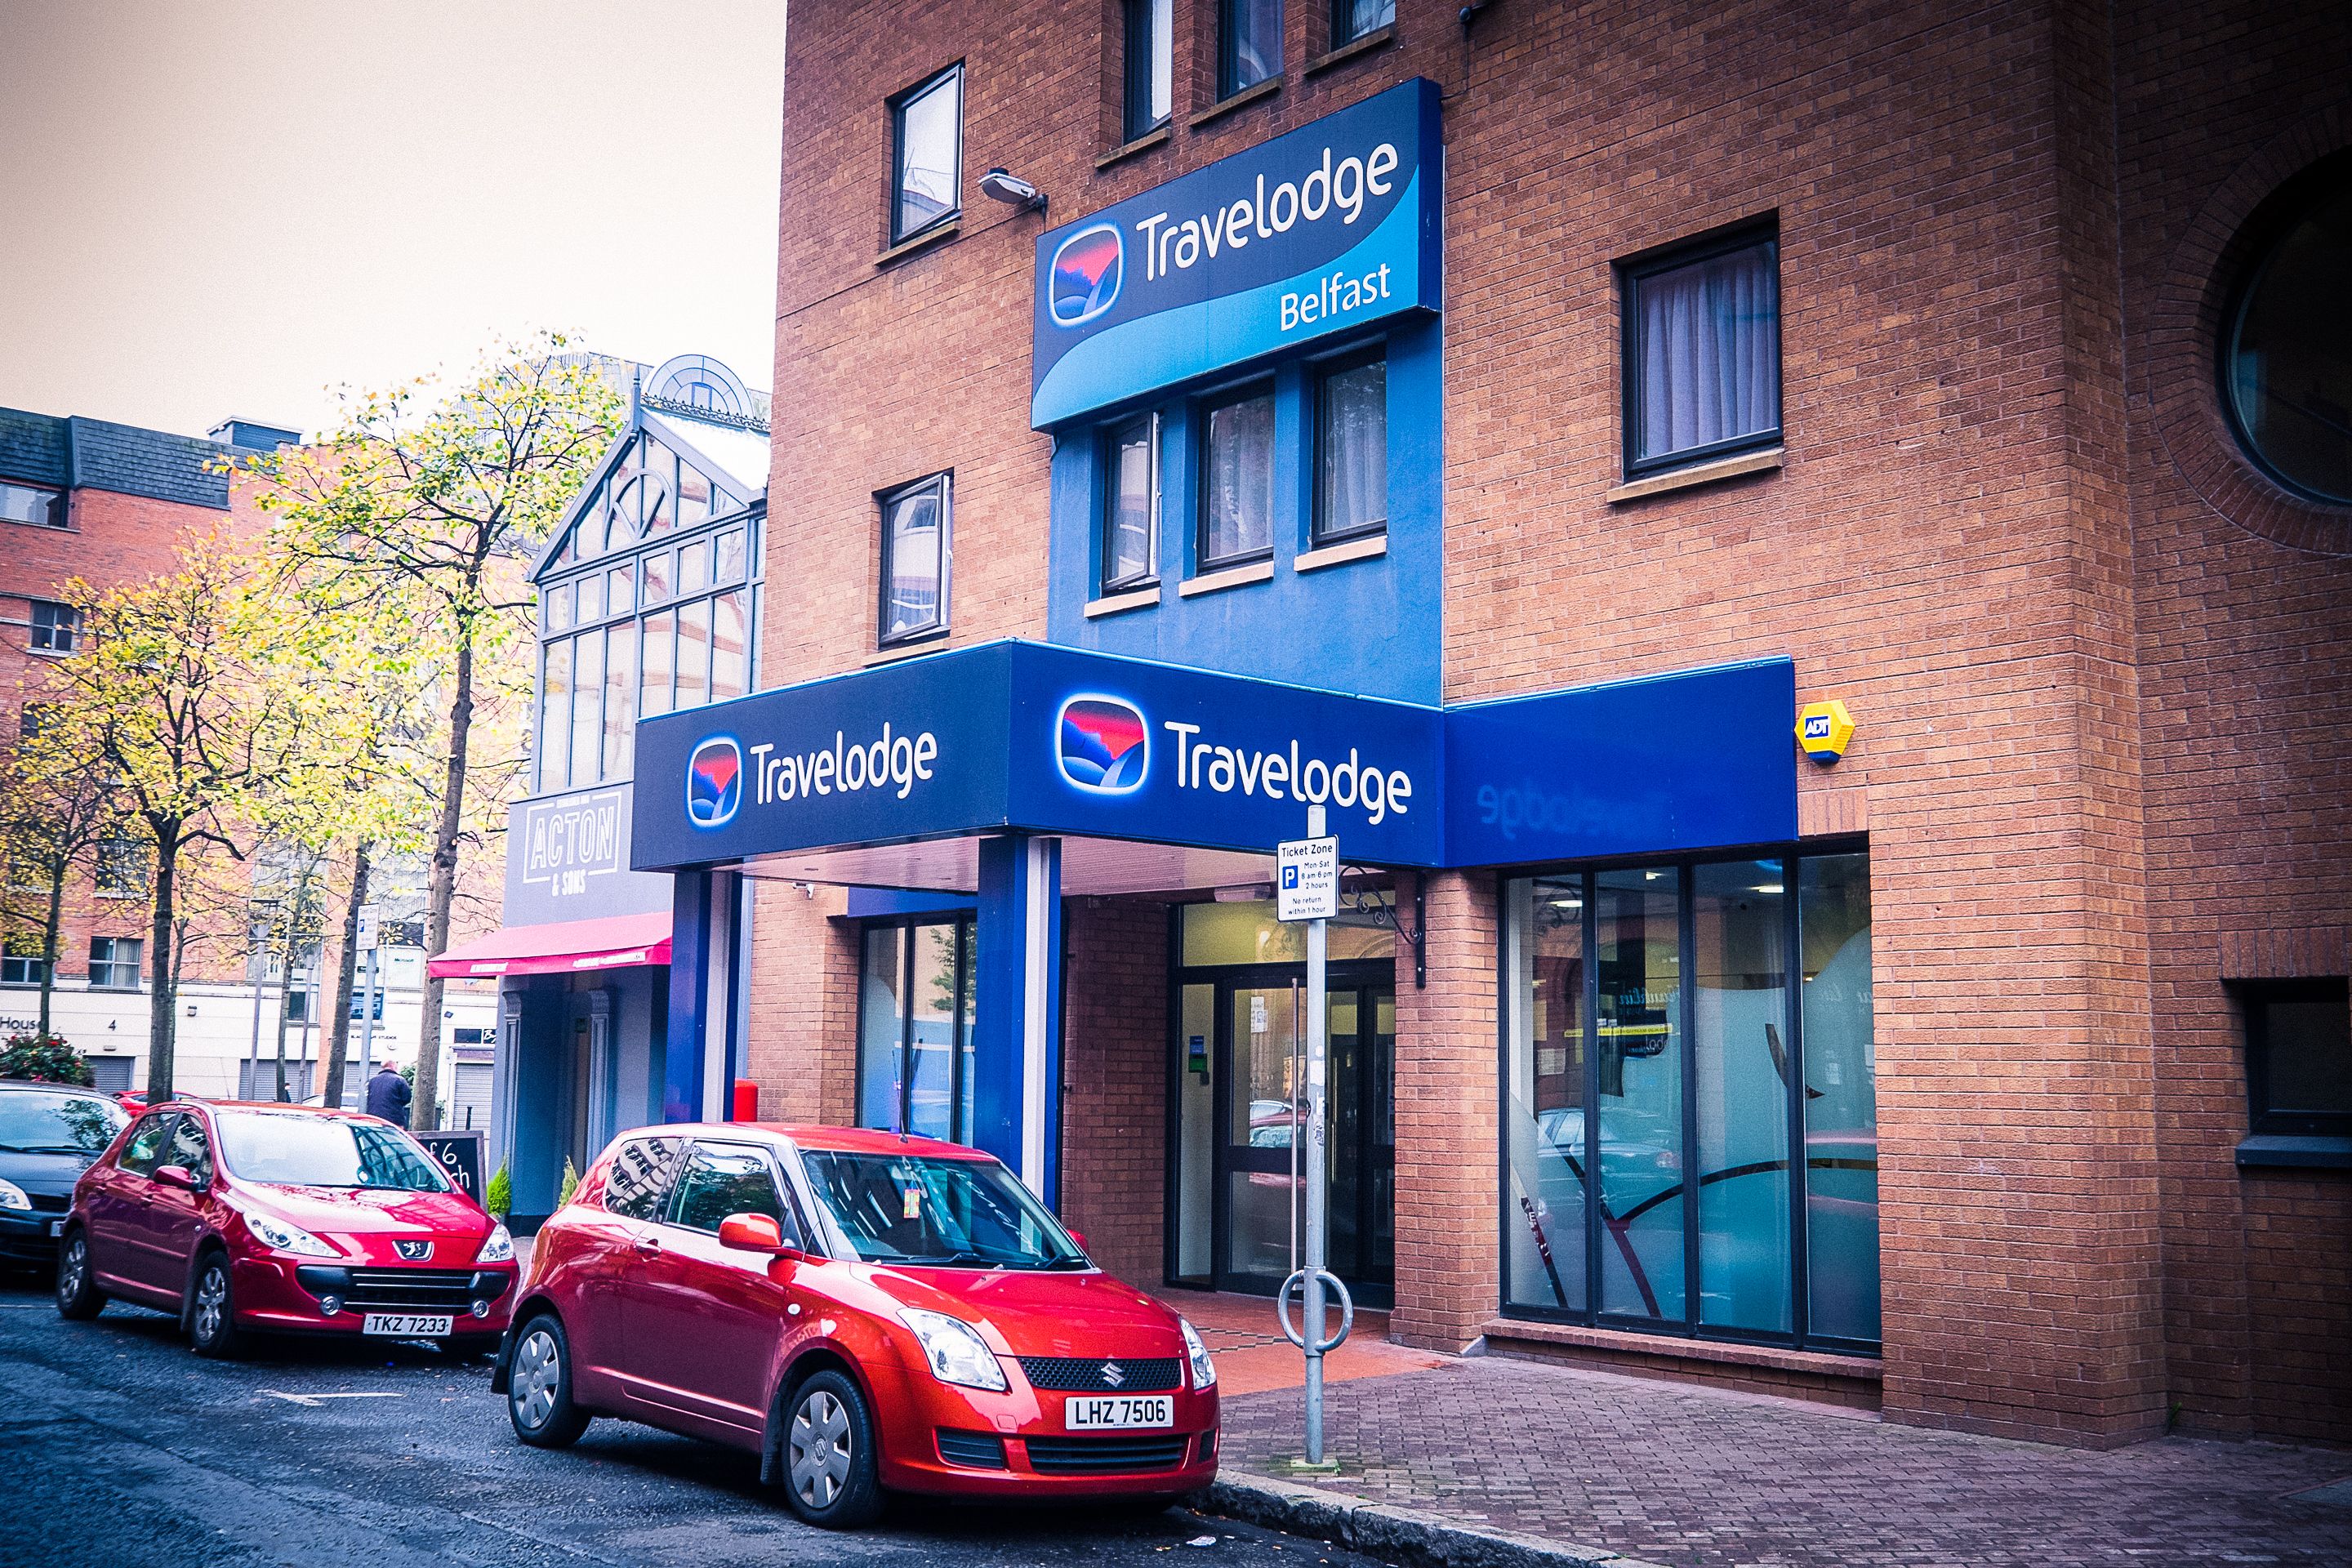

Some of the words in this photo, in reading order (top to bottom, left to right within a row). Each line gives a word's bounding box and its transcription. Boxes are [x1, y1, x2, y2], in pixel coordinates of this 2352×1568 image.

[1135, 142, 1398, 282] Travelodge
[1280, 262, 1392, 332] Belfast
[1805, 719, 1829, 736] ADT
[750, 721, 938, 805] Travelodge
[1164, 720, 1412, 826] Travelodge
[530, 805, 615, 871] ACTON
[1281, 845, 1308, 858] Ticket
[1311, 844, 1333, 854] Zone
[561, 869, 586, 896] SONS
[1285, 868, 1295, 887] P
[108, 1019, 116, 1031] 4
[372, 1316, 404, 1332] TKZ
[408, 1317, 447, 1333] 7233
[1076, 1401, 1114, 1424] LHZ
[1120, 1399, 1165, 1423] 7506
